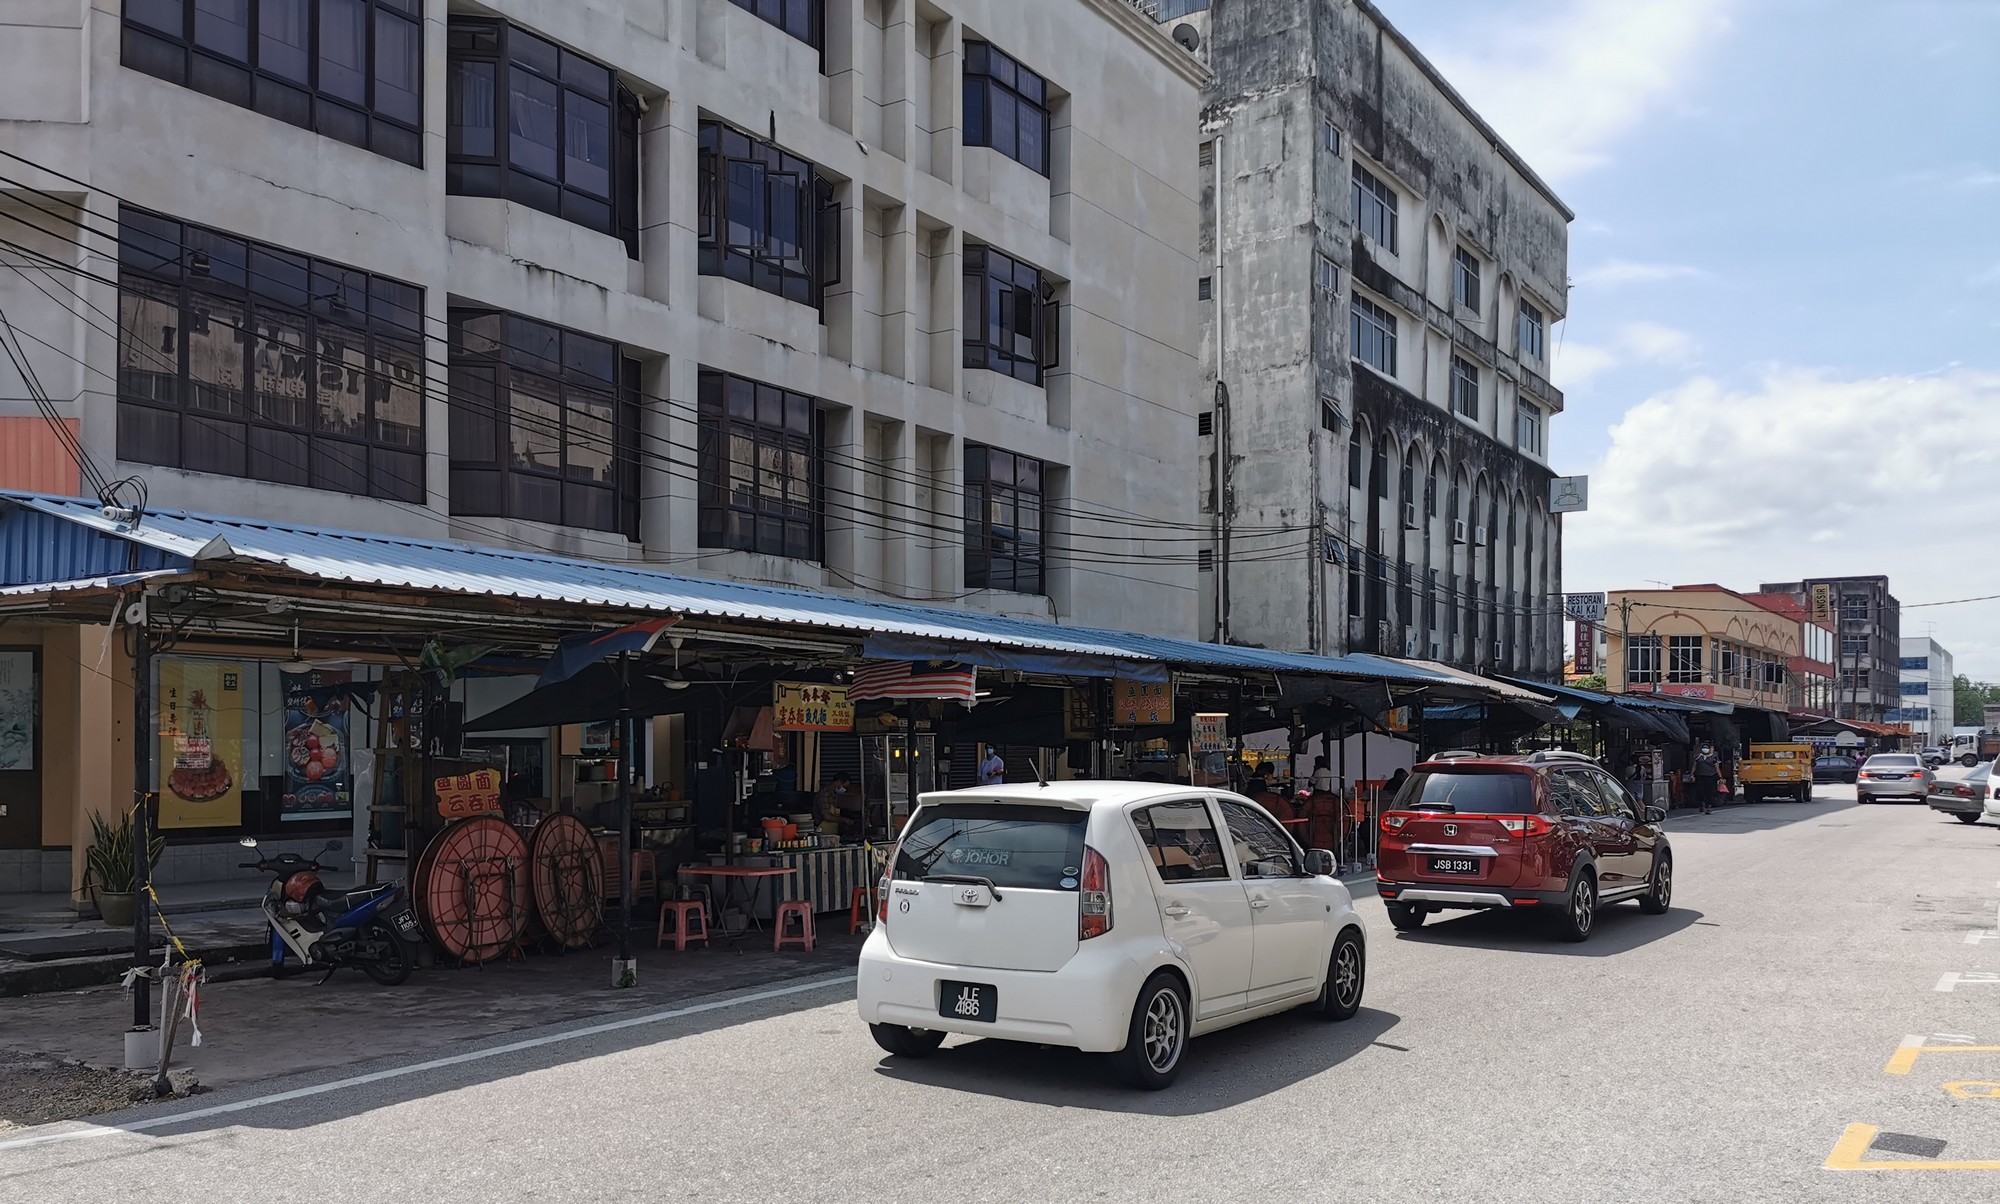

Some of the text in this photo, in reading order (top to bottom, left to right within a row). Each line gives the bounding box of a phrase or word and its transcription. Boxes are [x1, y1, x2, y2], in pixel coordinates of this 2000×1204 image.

[1568, 595, 1602, 605] RESTORAN
[1816, 588, 1826, 618] LANGSIR
[1571, 604, 1598, 615] KAI KAI
[965, 852, 1009, 865] JOHOR
[1434, 859, 1472, 871] JSB 1331
[398, 914, 410, 925] JFU
[954, 1000, 980, 1016] 4186
